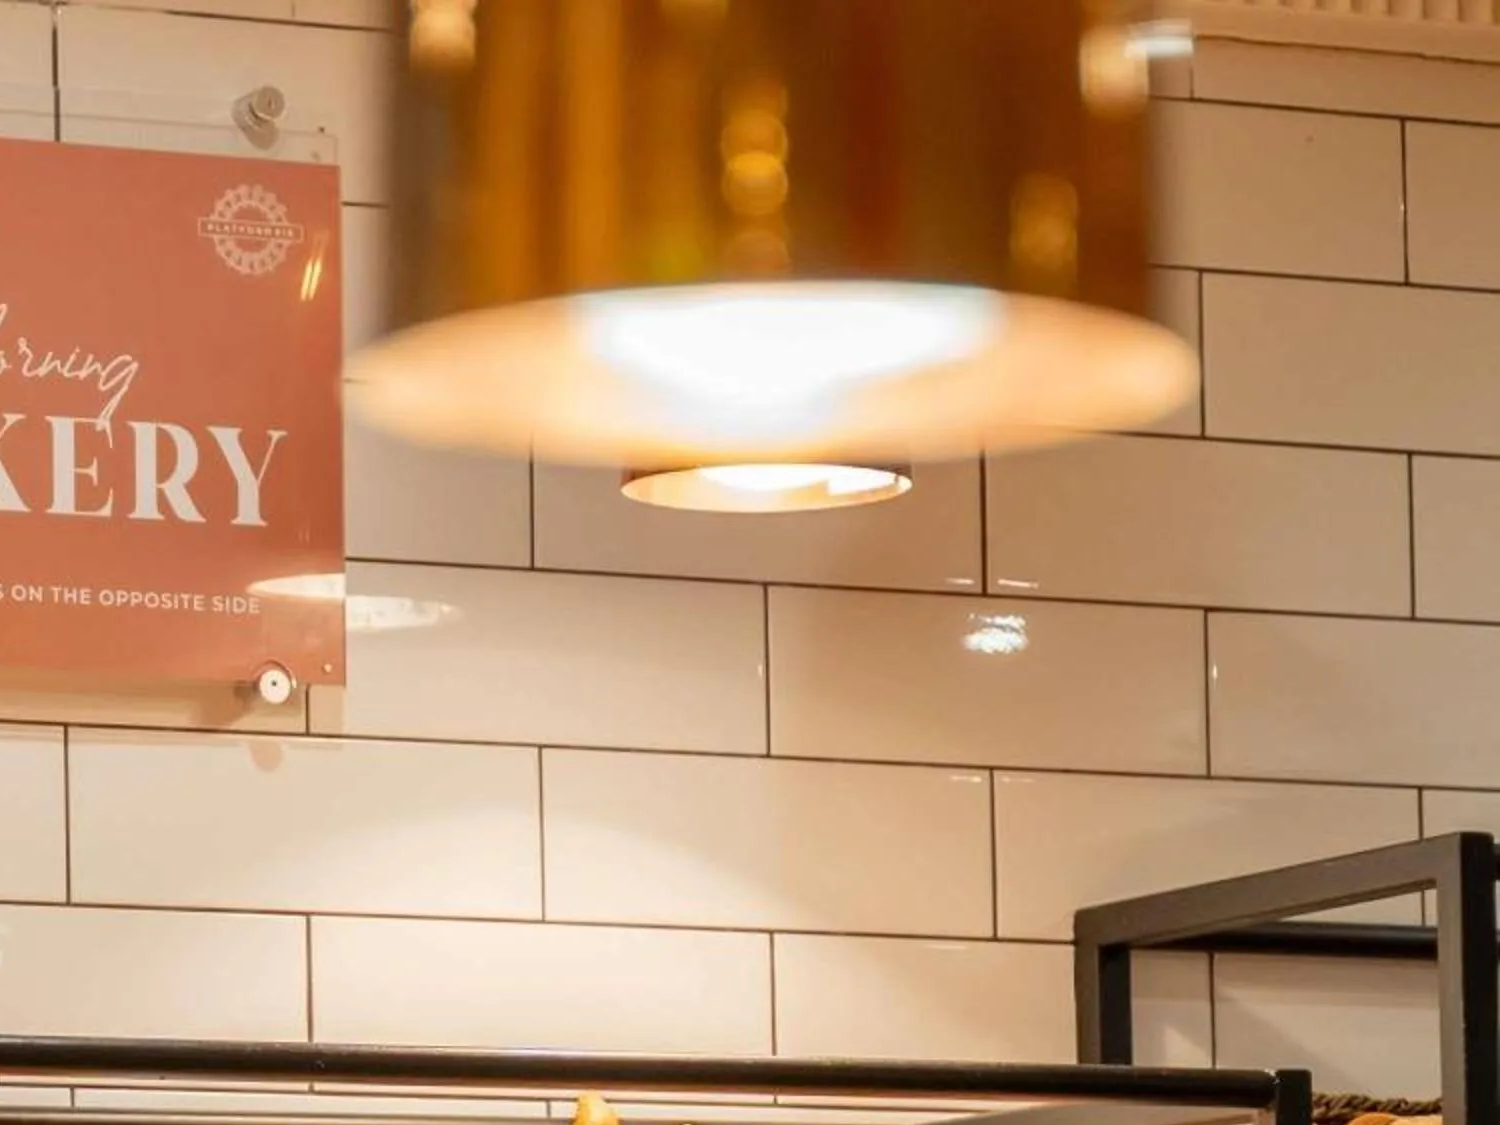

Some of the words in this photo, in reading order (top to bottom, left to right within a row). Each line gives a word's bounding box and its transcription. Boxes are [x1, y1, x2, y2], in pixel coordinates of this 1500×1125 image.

[11, 584, 43, 602] ON
[51, 586, 92, 606] THE
[99, 588, 205, 612] OPPOSITE
[212, 595, 261, 615] SIDE
